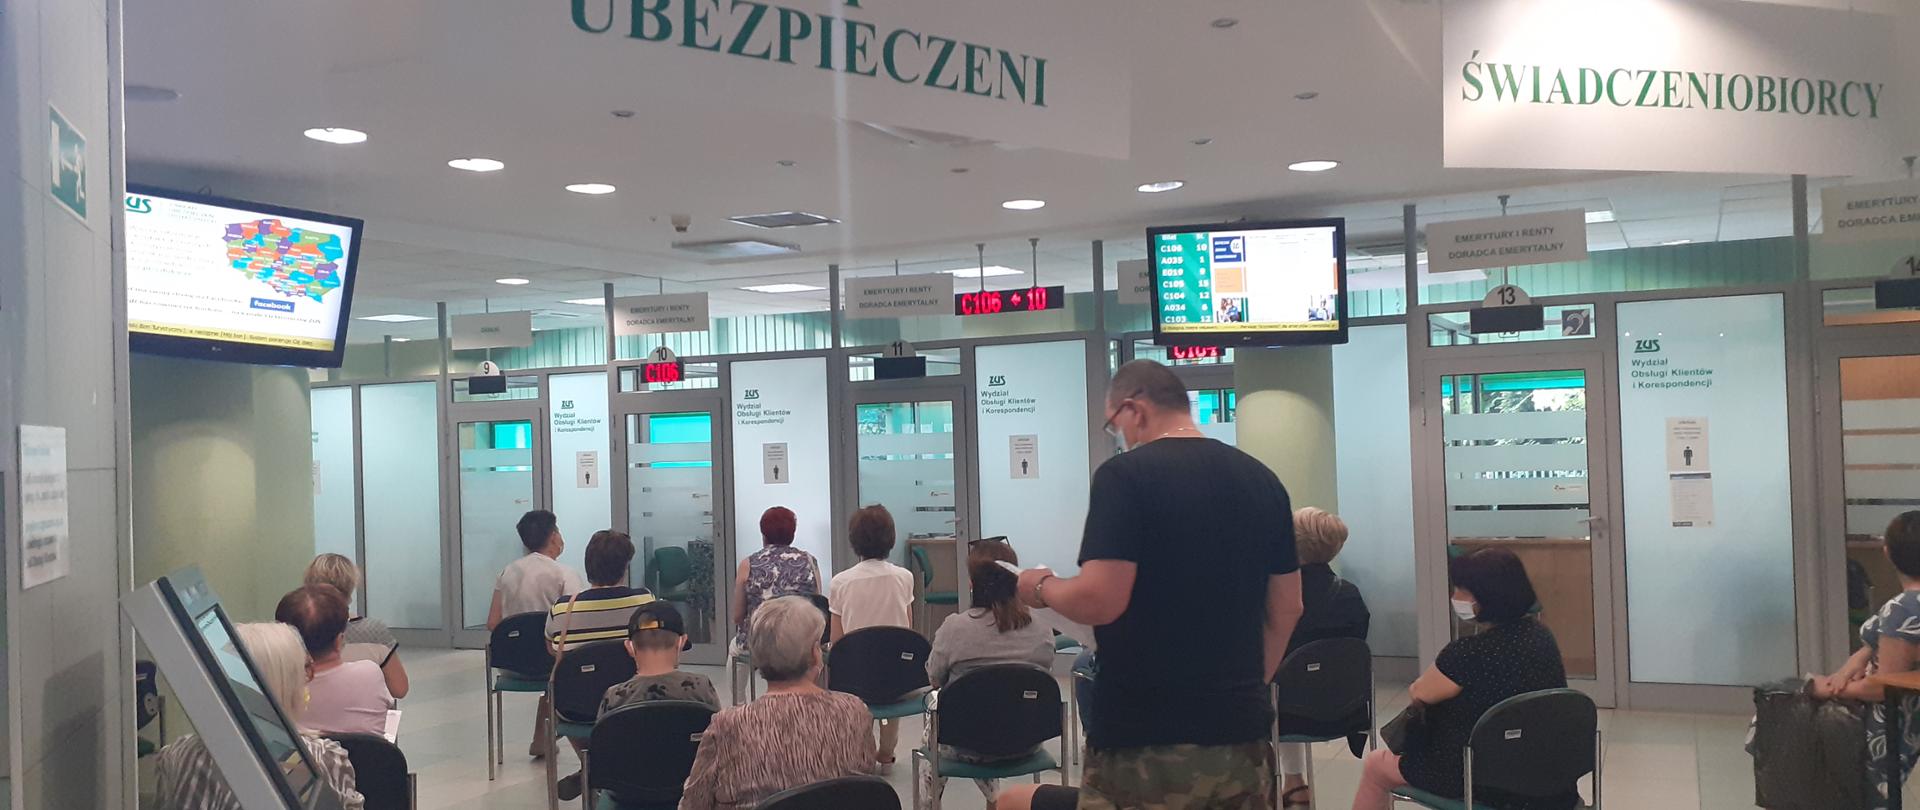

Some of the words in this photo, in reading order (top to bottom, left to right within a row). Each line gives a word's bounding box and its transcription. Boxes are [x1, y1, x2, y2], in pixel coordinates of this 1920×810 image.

[569, 0, 1049, 107] UBEZPIECZENI
[1462, 49, 1885, 119] ŚWIADCZENIOBIORCY
[1846, 195, 1919, 210] EMERYTURY
[1838, 215, 1896, 228] DORADCA
[1454, 230, 1514, 243] EMERYTURY
[1521, 227, 1554, 237] RENTY
[1196, 244, 1208, 252] 10
[1448, 246, 1497, 260] DORADCA
[1498, 242, 1564, 256] EMERYTALNY
[1199, 256, 1205, 264] 1
[863, 286, 906, 296] EMERYTURY
[910, 286, 932, 294] RENTY
[1497, 286, 1516, 305] 13
[254, 300, 291, 310] facebook
[859, 300, 892, 309] DORADCA
[893, 298, 938, 308] EMERYTALNY
[962, 292, 1002, 315] C106
[1026, 287, 1046, 310] 10
[892, 342, 902, 356] 11
[1634, 339, 1660, 354] ZUS
[656, 347, 668, 361] 10
[483, 362, 490, 374] 9
[645, 362, 679, 382] C106
[1671, 368, 1713, 376] Klientów
[988, 376, 1006, 386] ZUS
[1638, 379, 1712, 389] Korespondencji
[744, 389, 760, 400] ZUS
[986, 406, 1036, 414] Korespondencji
